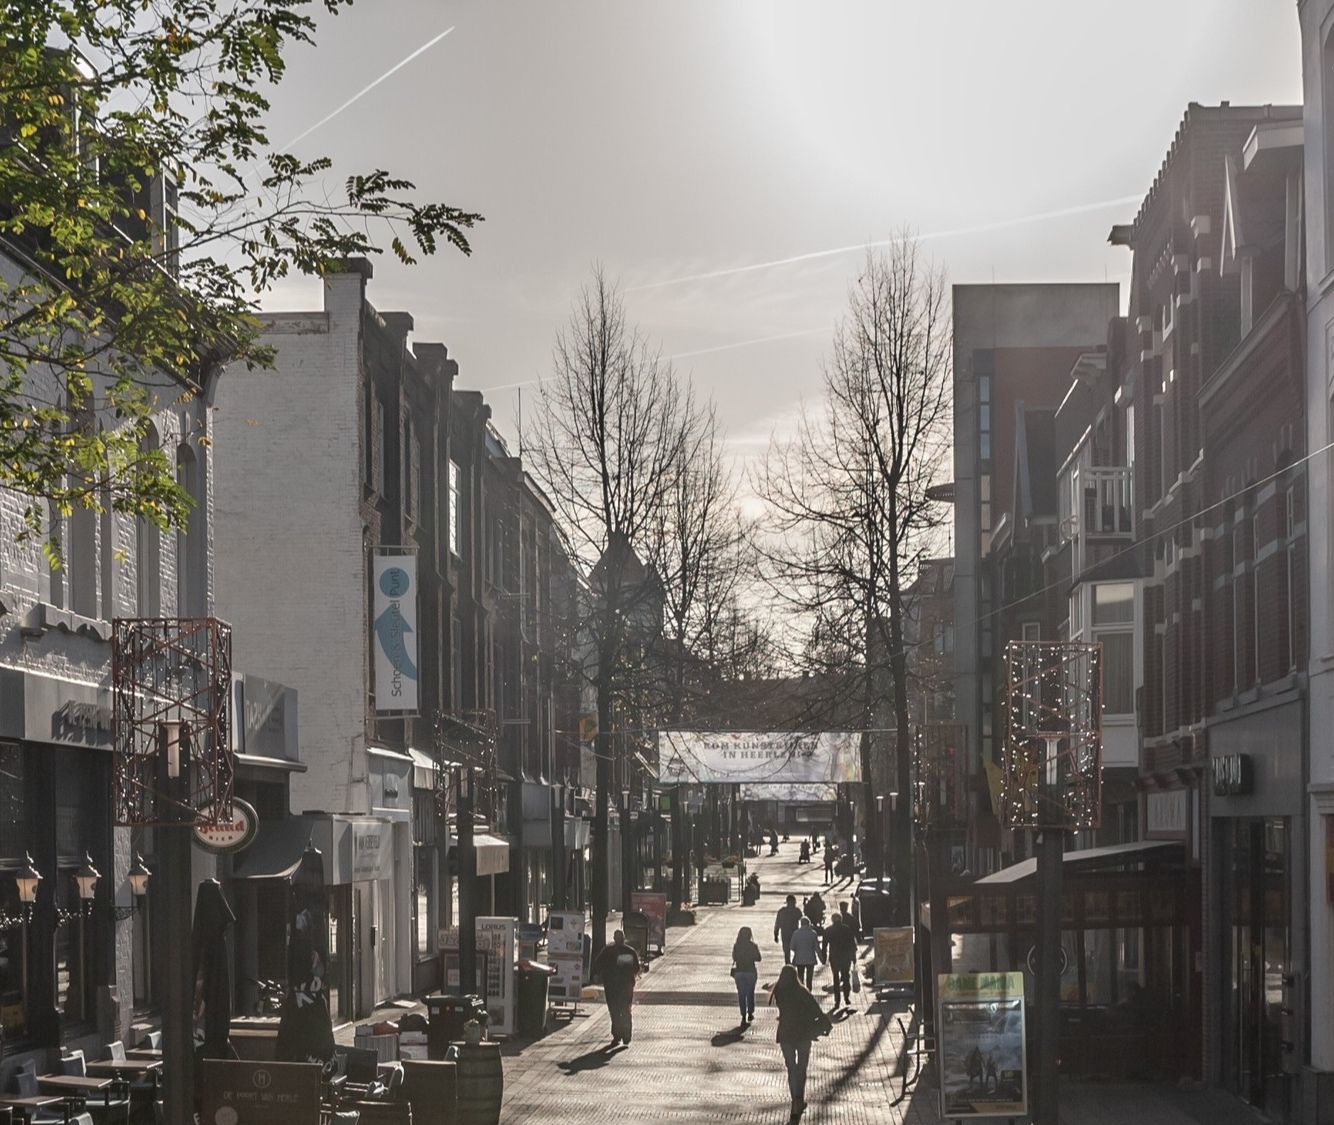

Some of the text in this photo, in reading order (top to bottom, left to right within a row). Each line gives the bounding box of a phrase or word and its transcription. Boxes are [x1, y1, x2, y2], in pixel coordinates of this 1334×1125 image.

[390, 569, 400, 596] Punt
[390, 600, 401, 639] Sleutel
[391, 655, 402, 697] Schoen
[723, 750, 736, 759] IN
